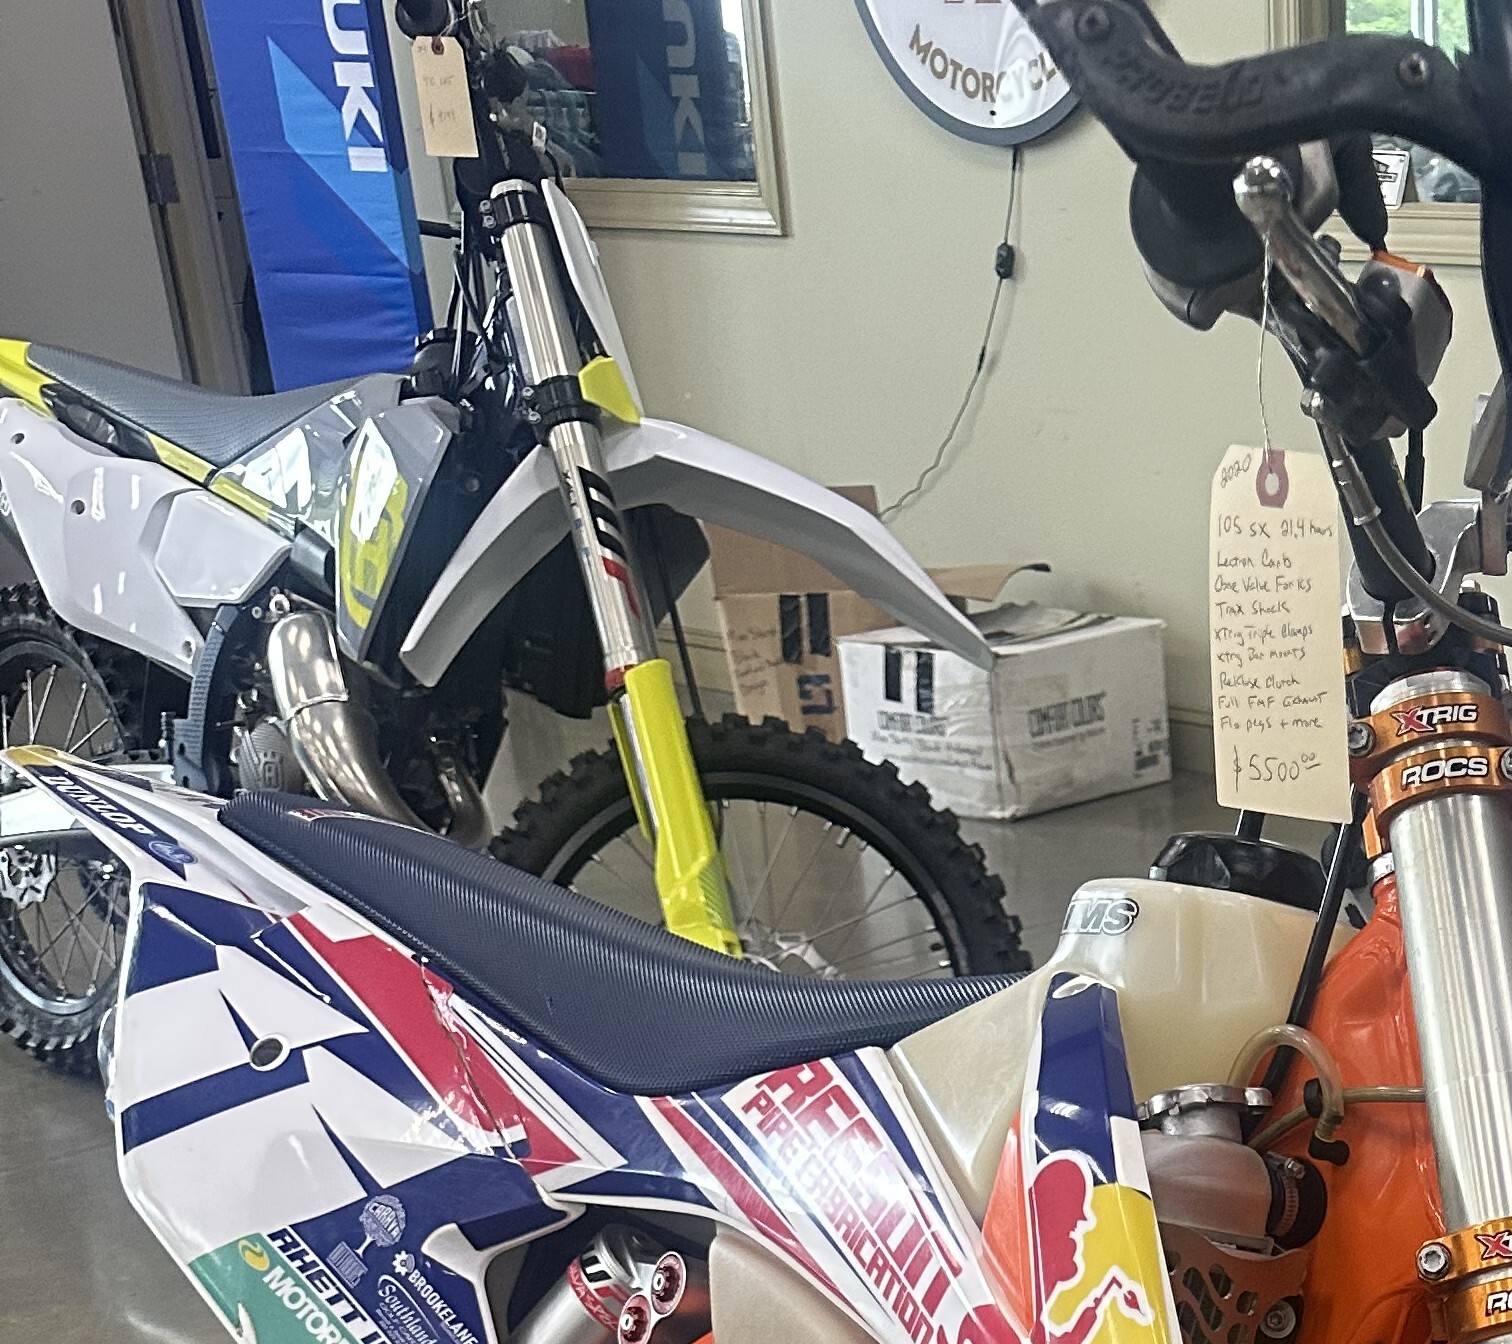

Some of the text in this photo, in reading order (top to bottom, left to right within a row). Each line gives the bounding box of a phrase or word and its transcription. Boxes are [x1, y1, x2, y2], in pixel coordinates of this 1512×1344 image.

[1221, 454, 1252, 488] 2020
[1281, 518, 1305, 539] 21.4
[1394, 704, 1478, 735] XTRIG
[1401, 755, 1489, 786] ROCS
[39, 776, 157, 835] DUNLOP
[1061, 899, 1139, 935] IMS
[267, 1227, 367, 1325] RHETT
